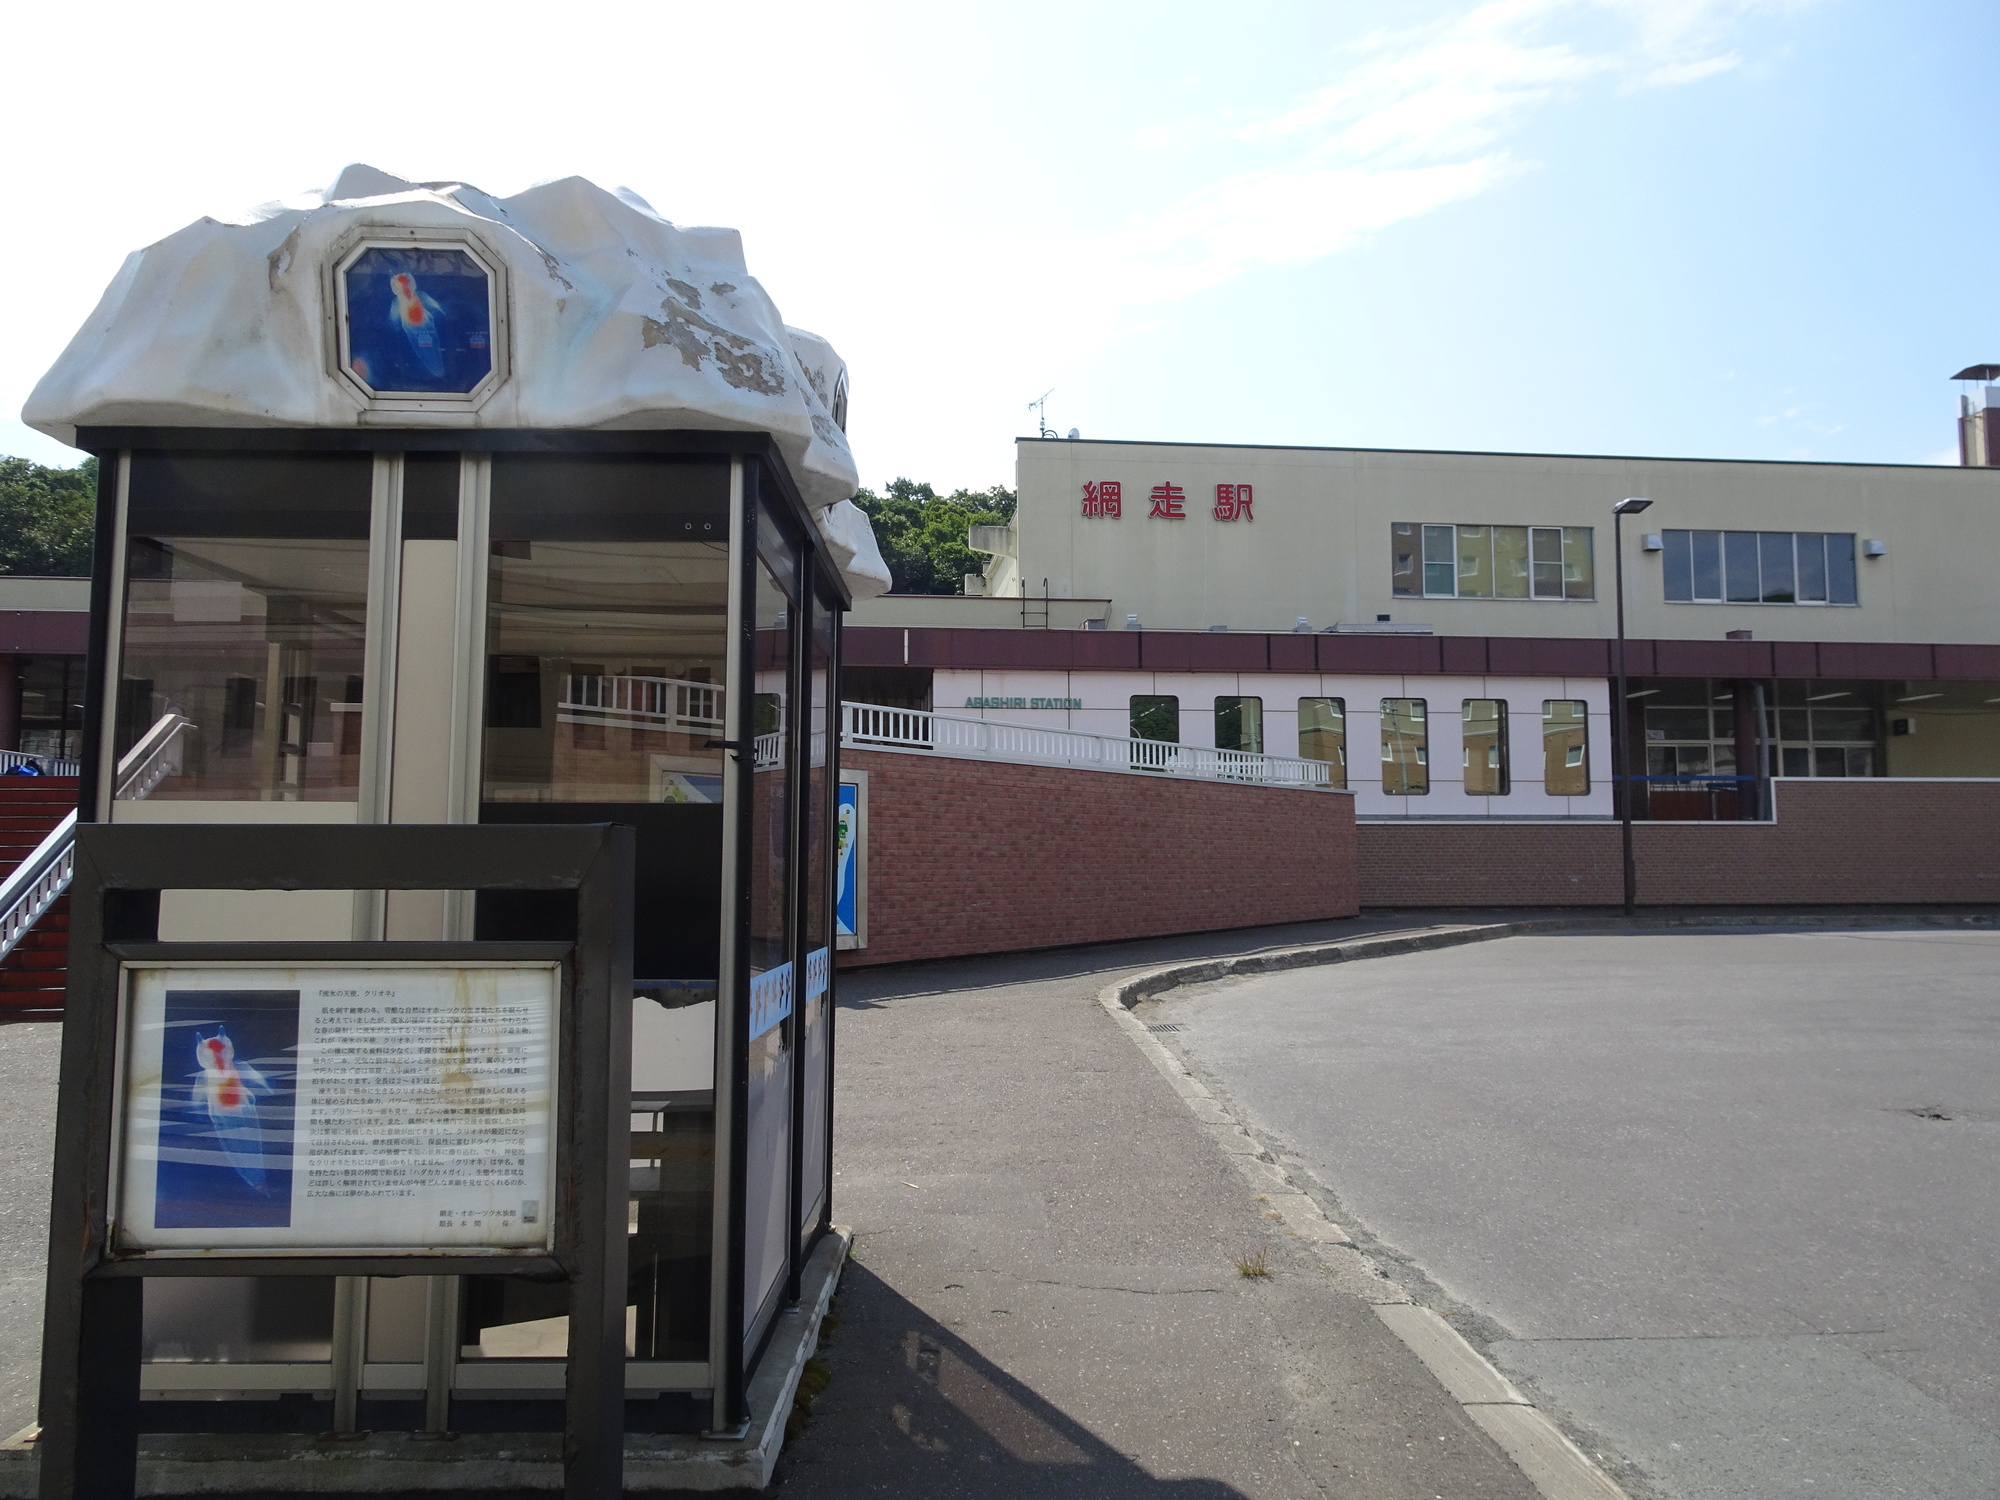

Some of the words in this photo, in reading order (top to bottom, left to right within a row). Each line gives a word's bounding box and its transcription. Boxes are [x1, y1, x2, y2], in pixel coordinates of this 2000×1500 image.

[1082, 481, 1254, 521] 網走駅
[965, 696, 1026, 709] ABASHIRI
[1030, 697, 1082, 710] STATION
